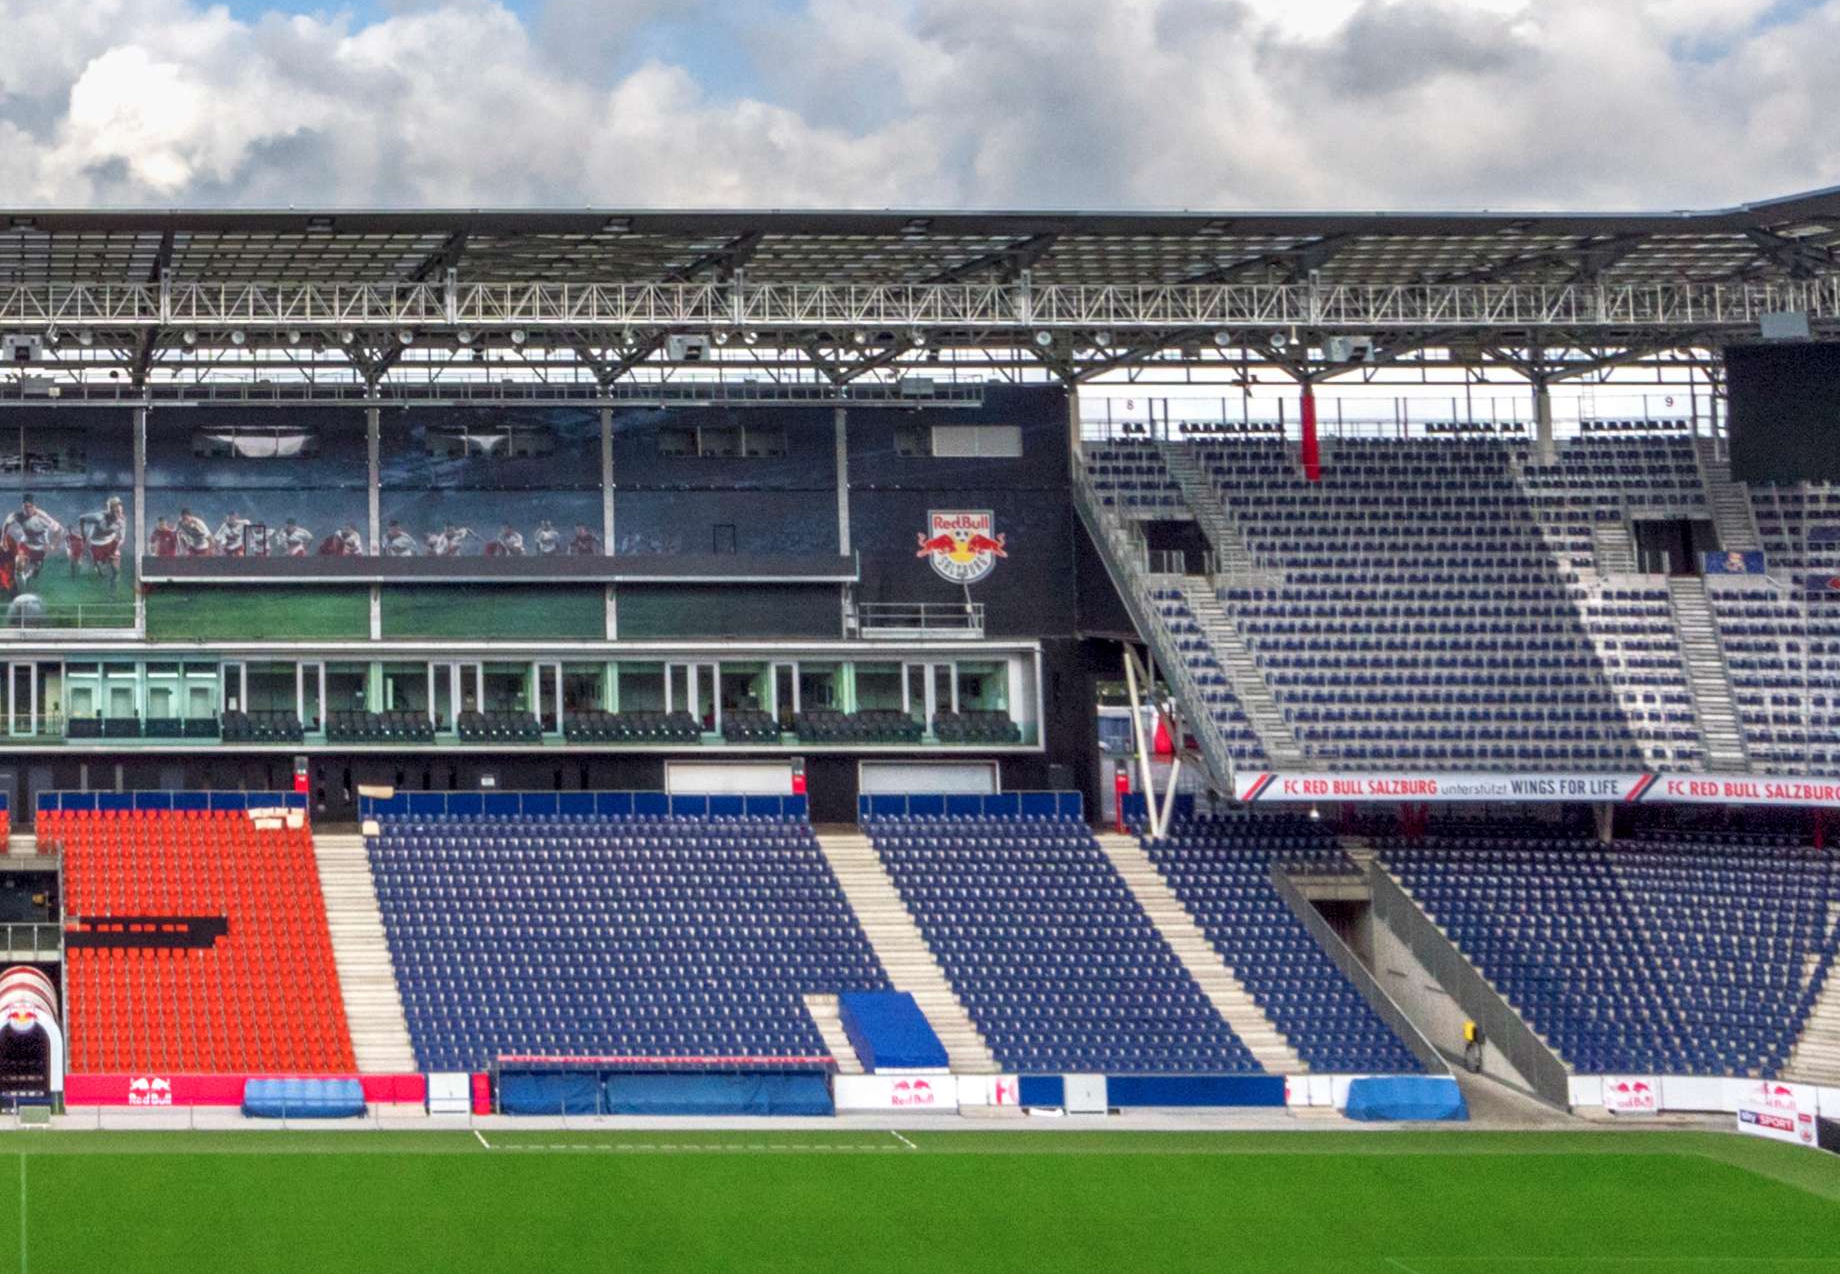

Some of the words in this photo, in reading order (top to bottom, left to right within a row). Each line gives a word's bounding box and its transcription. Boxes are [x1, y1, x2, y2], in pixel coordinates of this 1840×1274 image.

[1664, 395, 1674, 408] 9
[1284, 780, 1300, 795] FC
[1303, 781, 1329, 795] RED
[1332, 780, 1365, 796] BULL
[1367, 780, 1438, 796] SALZBURG
[1440, 780, 1508, 797] unterstützt
[1510, 779, 1557, 796] WINGS
[1559, 780, 1587, 796] FOR
[1589, 779, 1620, 796] LIFE
[1667, 780, 1686, 797] FC
[1689, 781, 1719, 798] RED
[1723, 782, 1761, 799] BULL
[1759, 1113, 1792, 1131] SPORT
